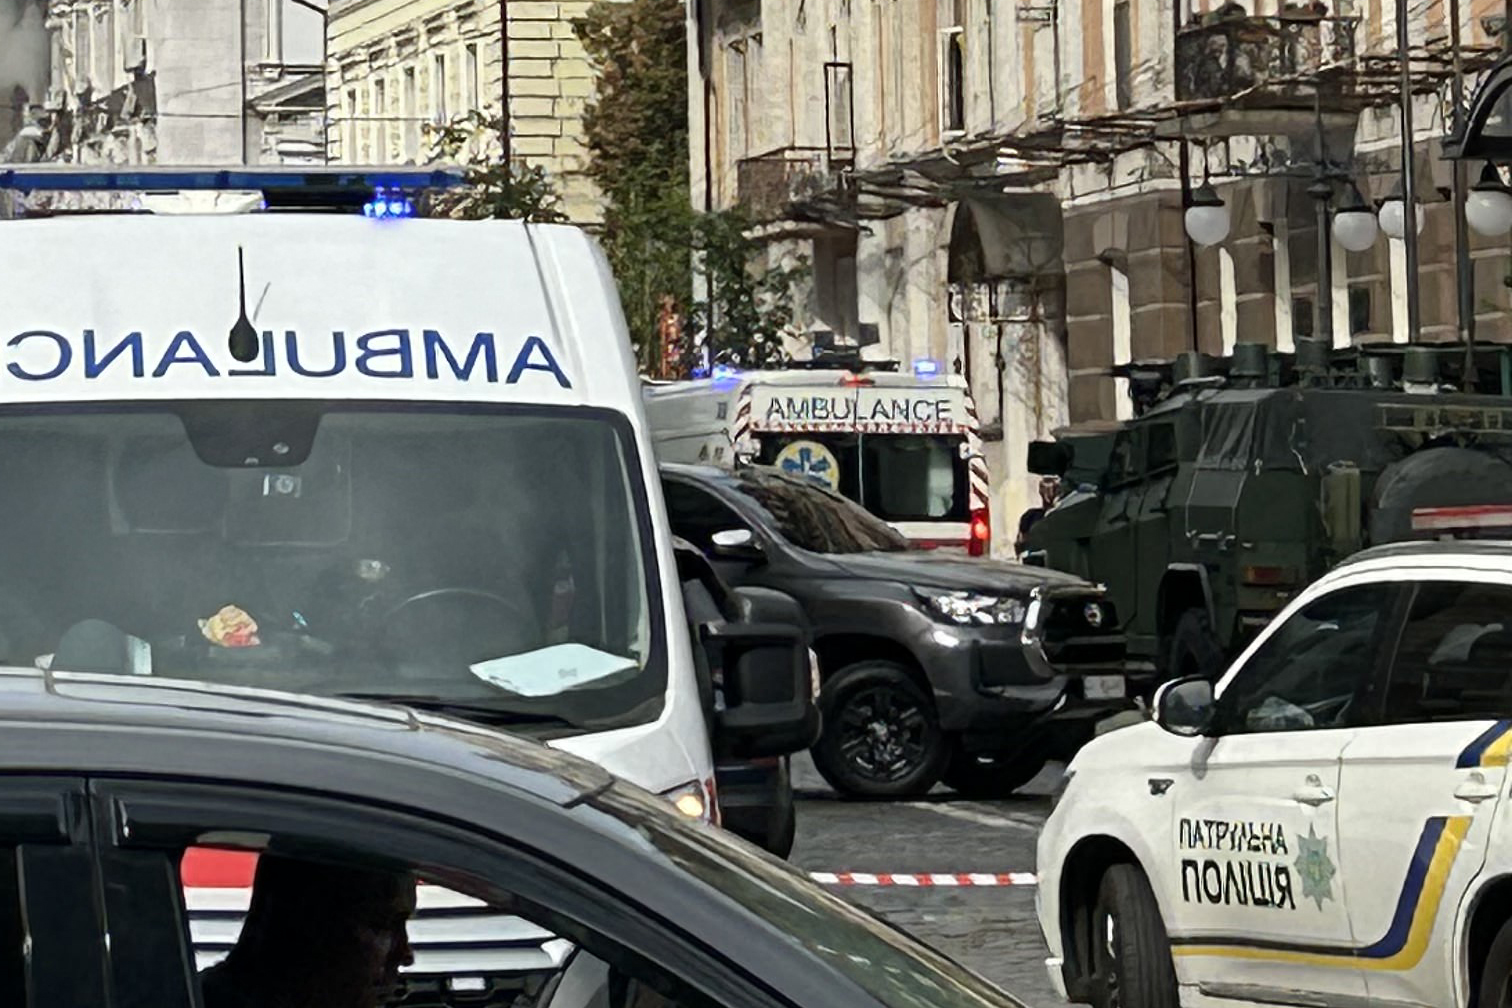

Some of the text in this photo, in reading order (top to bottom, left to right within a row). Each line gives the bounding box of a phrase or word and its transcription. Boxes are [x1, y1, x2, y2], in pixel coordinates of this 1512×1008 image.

[765, 396, 952, 423] AMBULANCE
[1179, 818, 1288, 855] ПАТРУЛЬНА
[1181, 858, 1296, 910] ПОЛІЦІЯ
